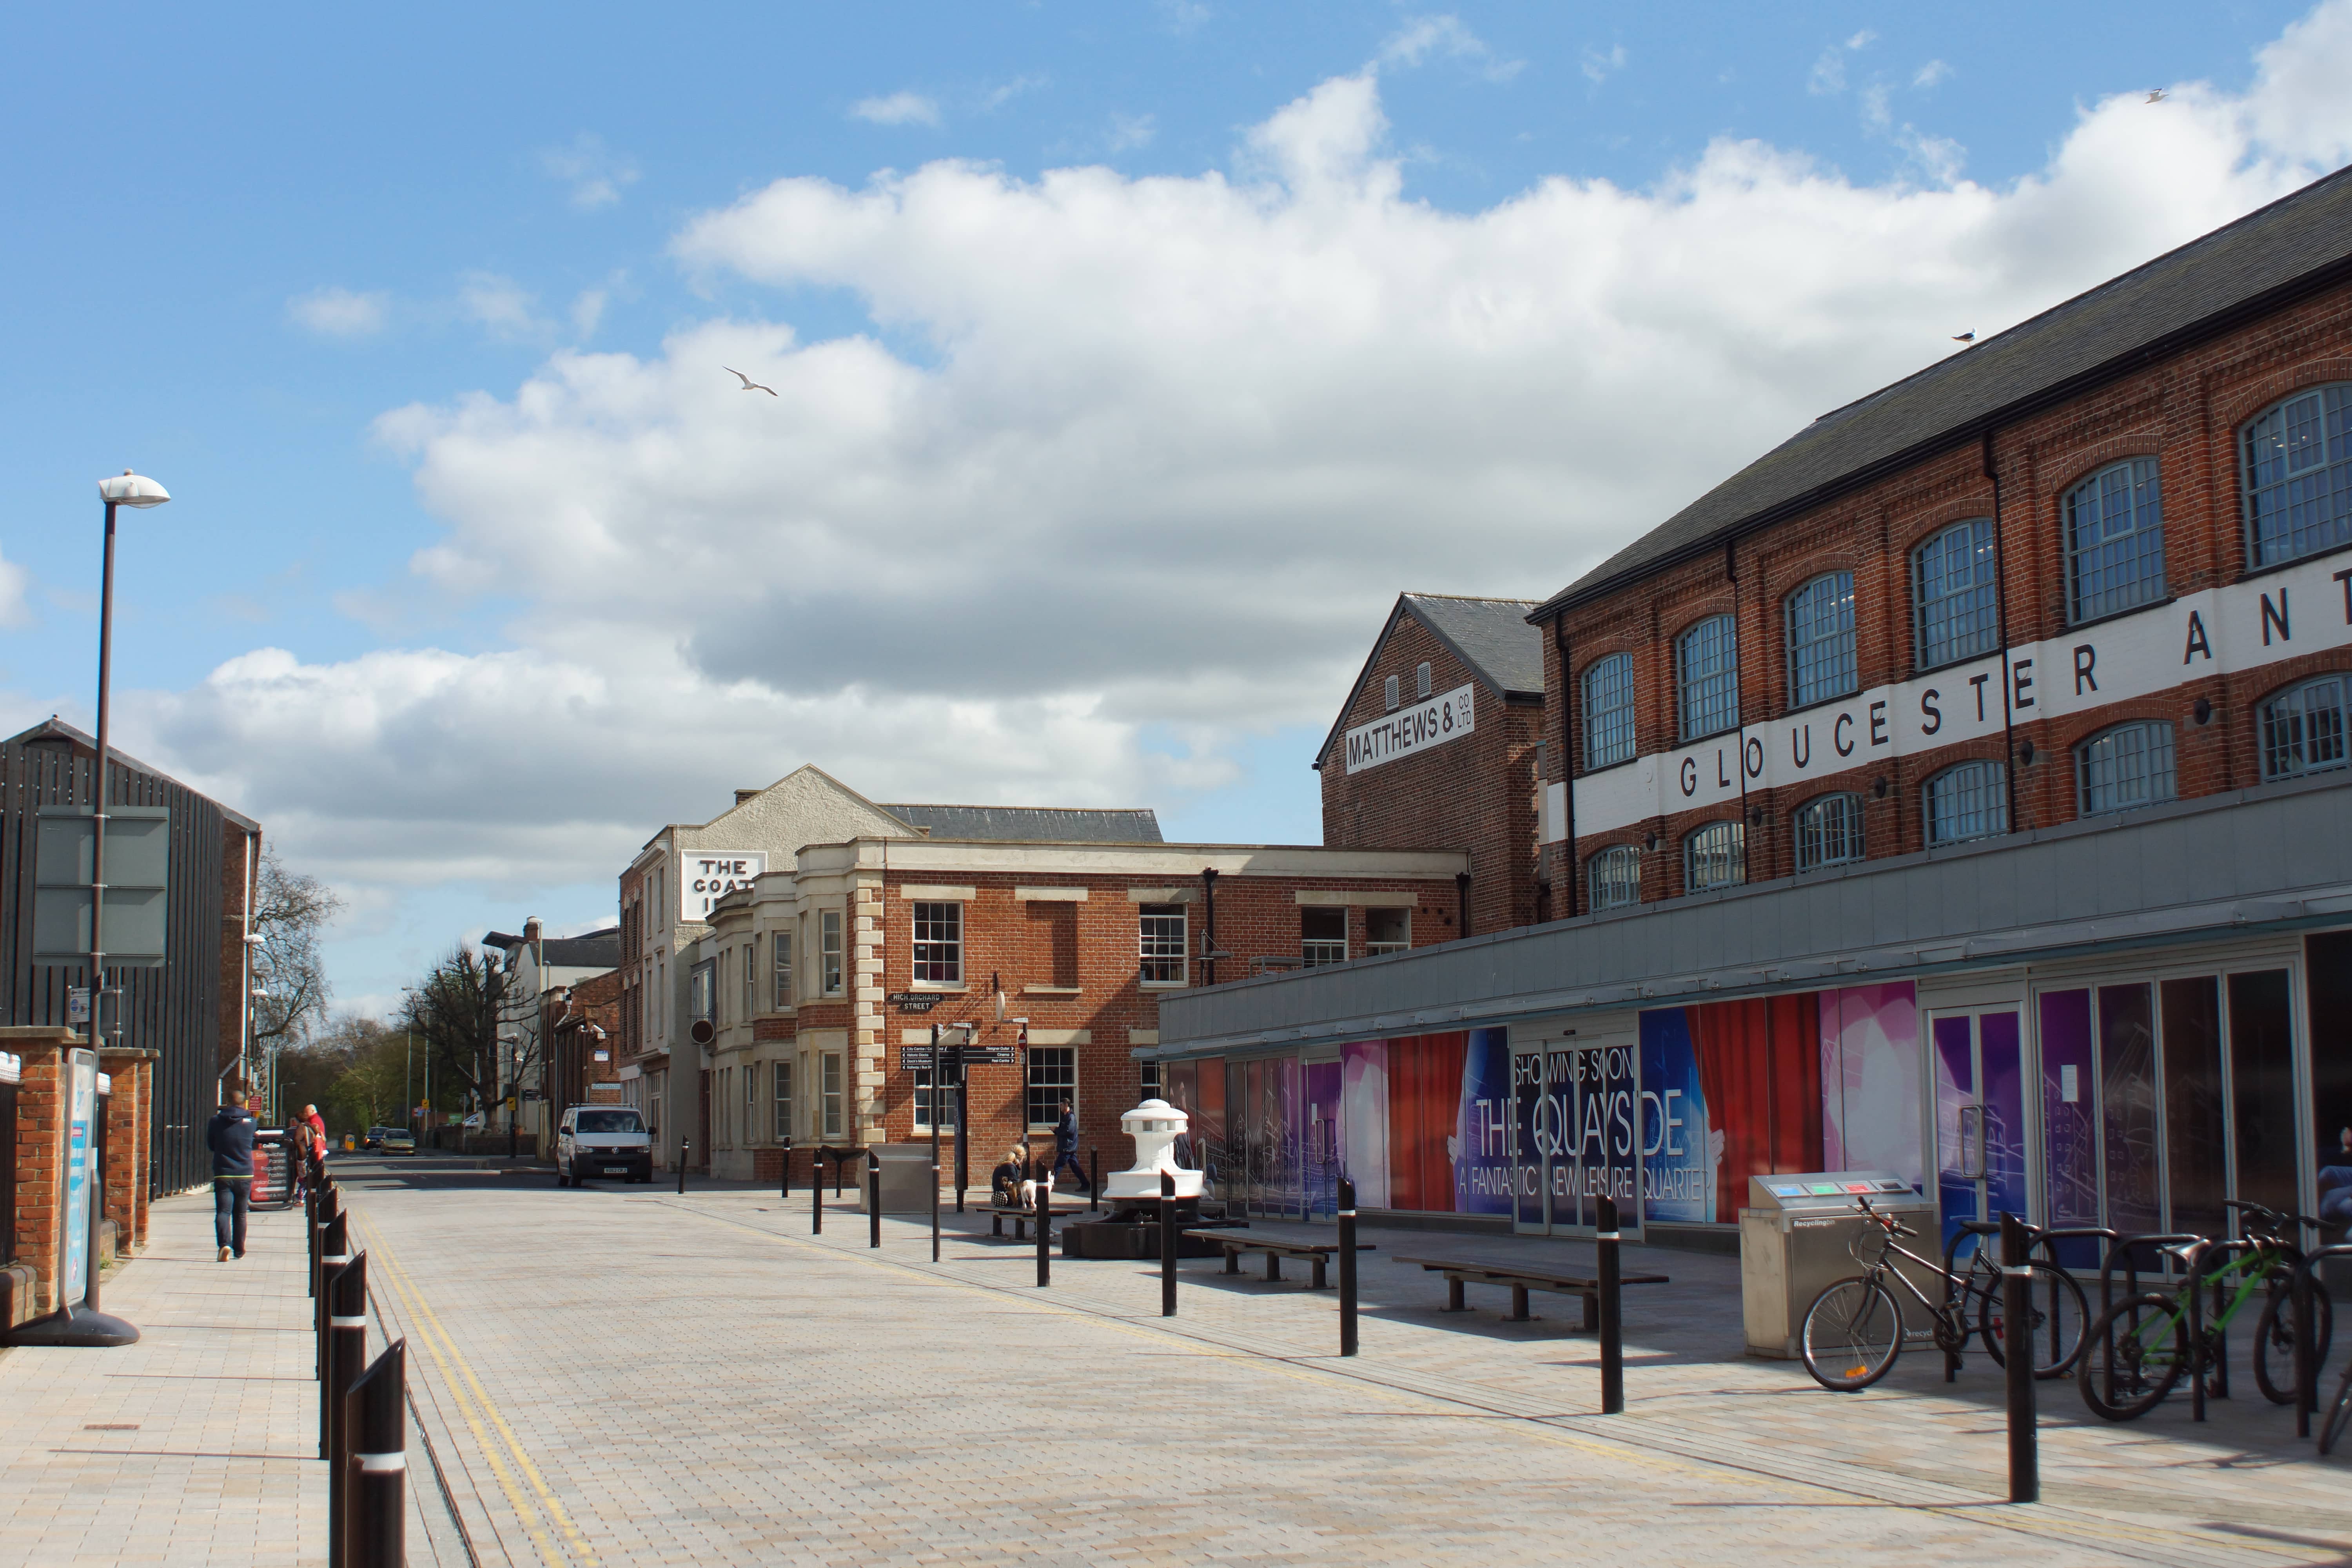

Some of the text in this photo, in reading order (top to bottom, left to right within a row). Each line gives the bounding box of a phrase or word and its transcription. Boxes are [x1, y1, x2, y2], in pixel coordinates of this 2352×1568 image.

[1681, 568, 2352, 796] GLOUCESTER ANT
[1457, 710, 1471, 728] LTD
[1459, 693, 1469, 710] CO
[1349, 701, 1454, 767] MATTHEWS &
[700, 860, 746, 874] THE
[693, 879, 755, 893] GOAT
[1516, 1047, 1633, 1085] SHOWING SOON
[1476, 1097, 1522, 1156] THE
[1459, 1167, 1468, 1195] A
[1472, 1166, 1537, 1196] FANTASTIC
[1583, 1166, 1632, 1198] LEISURE
[1644, 1167, 1711, 1201] QUARTER
